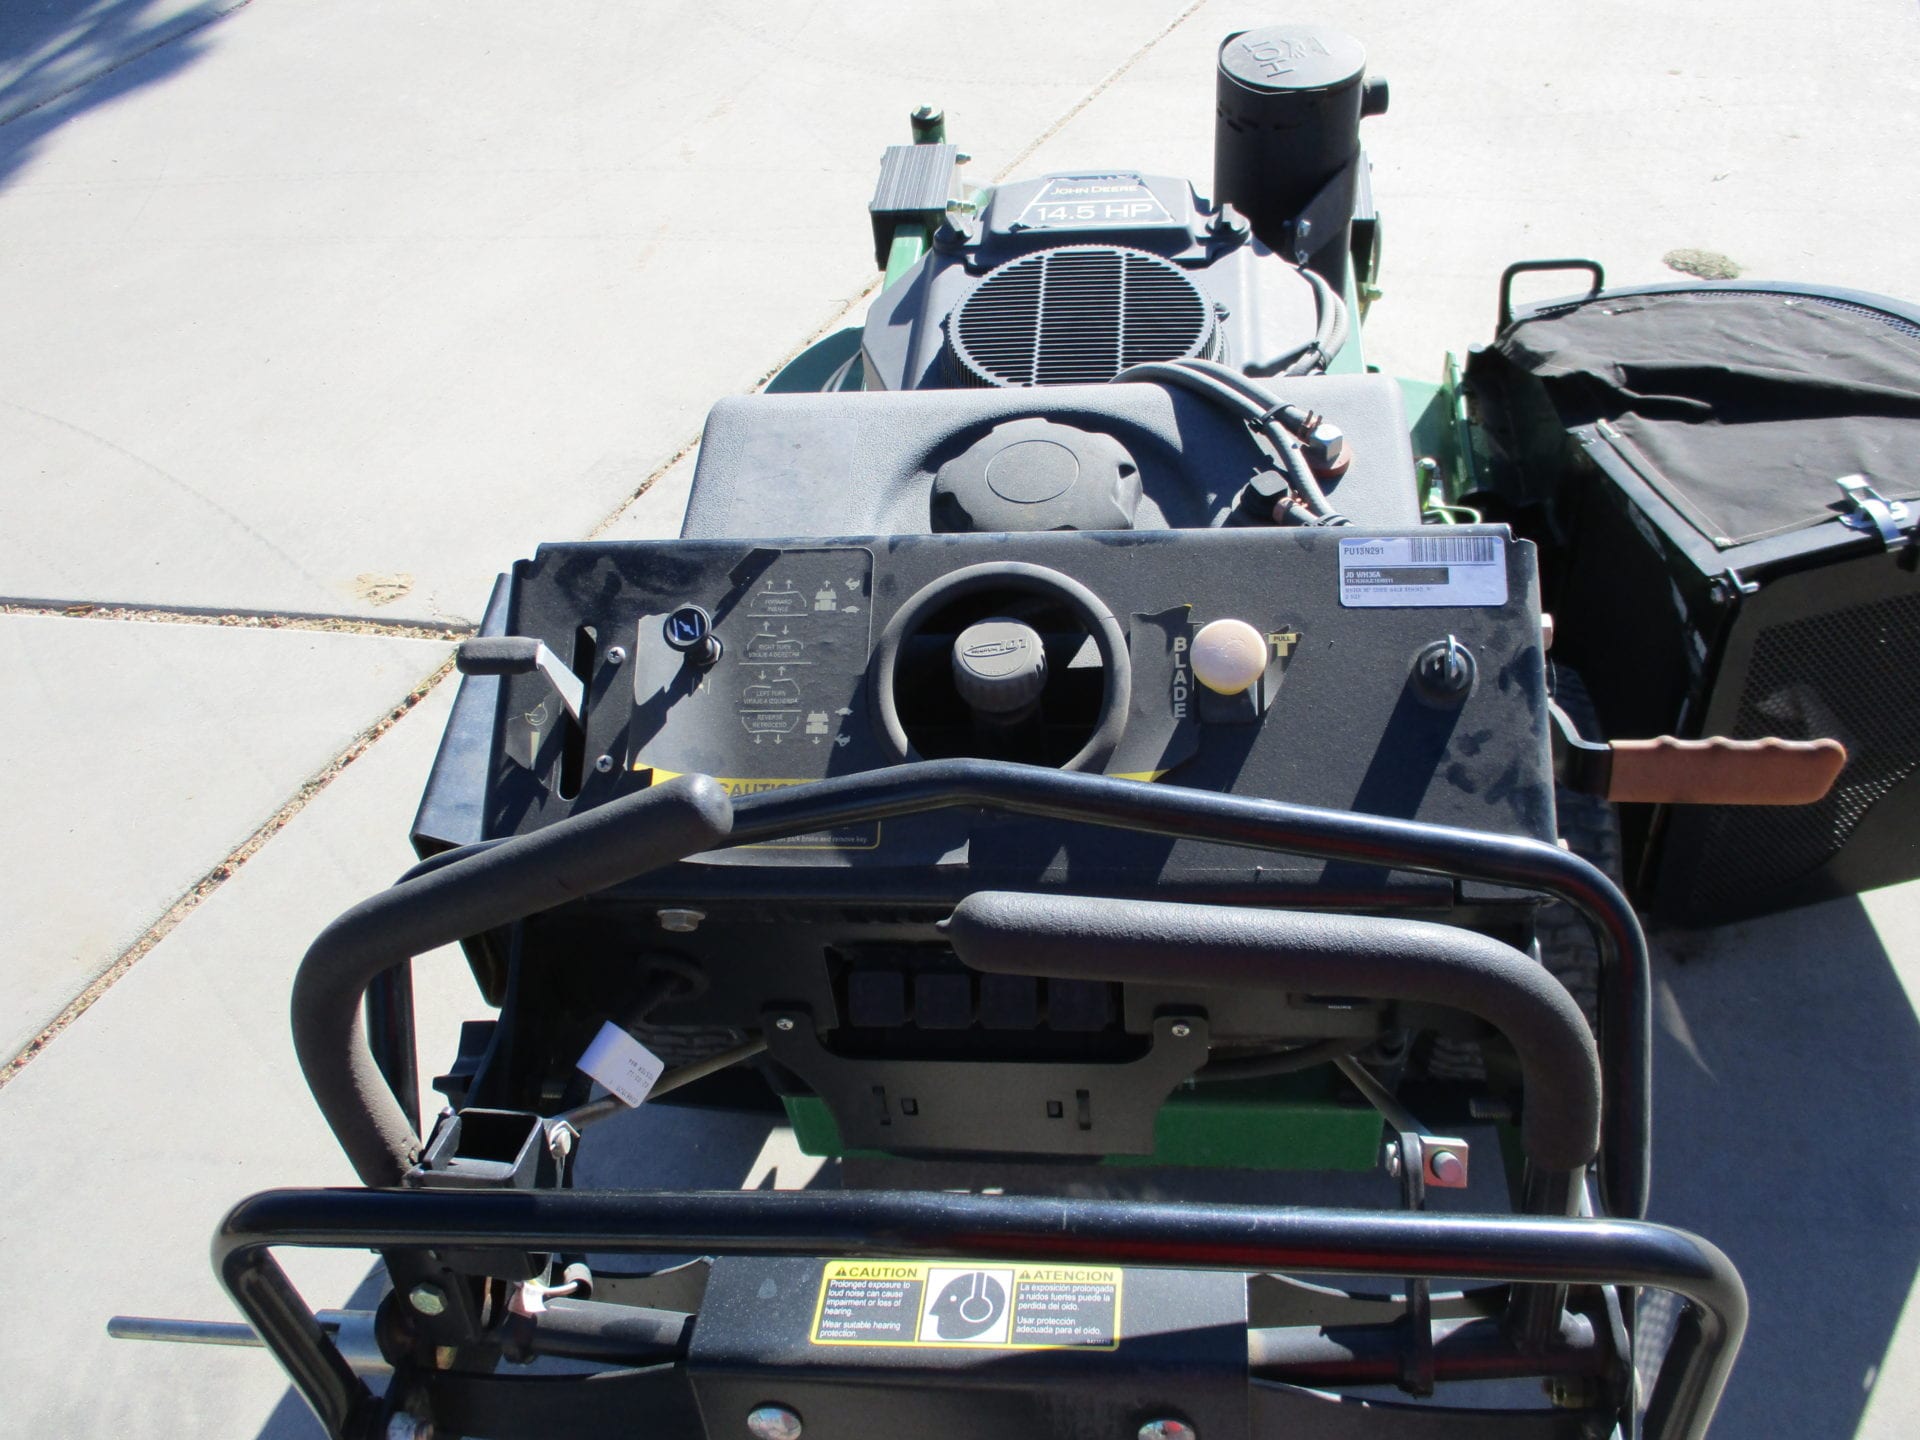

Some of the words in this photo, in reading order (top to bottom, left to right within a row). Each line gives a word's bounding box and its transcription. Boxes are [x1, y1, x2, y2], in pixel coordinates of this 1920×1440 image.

[1051, 187, 1089, 195] JOHN
[1091, 185, 1139, 193] DEERE
[1037, 205, 1096, 221] 14.5
[1105, 203, 1153, 219] HP
[1173, 636, 1188, 718] BLADE
[849, 1267, 918, 1278] CAUTION
[1034, 1270, 1113, 1282] ATENCION
[830, 1280, 867, 1290] Prolonged
[868, 1281, 902, 1290] exposure
[903, 1281, 911, 1289] to
[1020, 1283, 1030, 1291] La
[1031, 1283, 1071, 1292] exposición
[1072, 1285, 1114, 1293] prolongada
[828, 1289, 844, 1297] loud
[845, 1289, 865, 1297] noise
[1050, 1293, 1077, 1301] fuertes
[1077, 1294, 1101, 1302] puede
[826, 1298, 866, 1307] impairment
[893, 1299, 901, 1307] of
[1047, 1302, 1060, 1310] del
[822, 1320, 842, 1328] Wear
[843, 1320, 872, 1329] suitable
[873, 1321, 901, 1331] hearing
[1017, 1316, 1035, 1324] Usar
[1036, 1316, 1076, 1326] protección
[820, 1329, 858, 1338] protection.
[1016, 1325, 1053, 1334] adecuada
[1055, 1327, 1072, 1335] para
[1074, 1326, 1082, 1334] el
